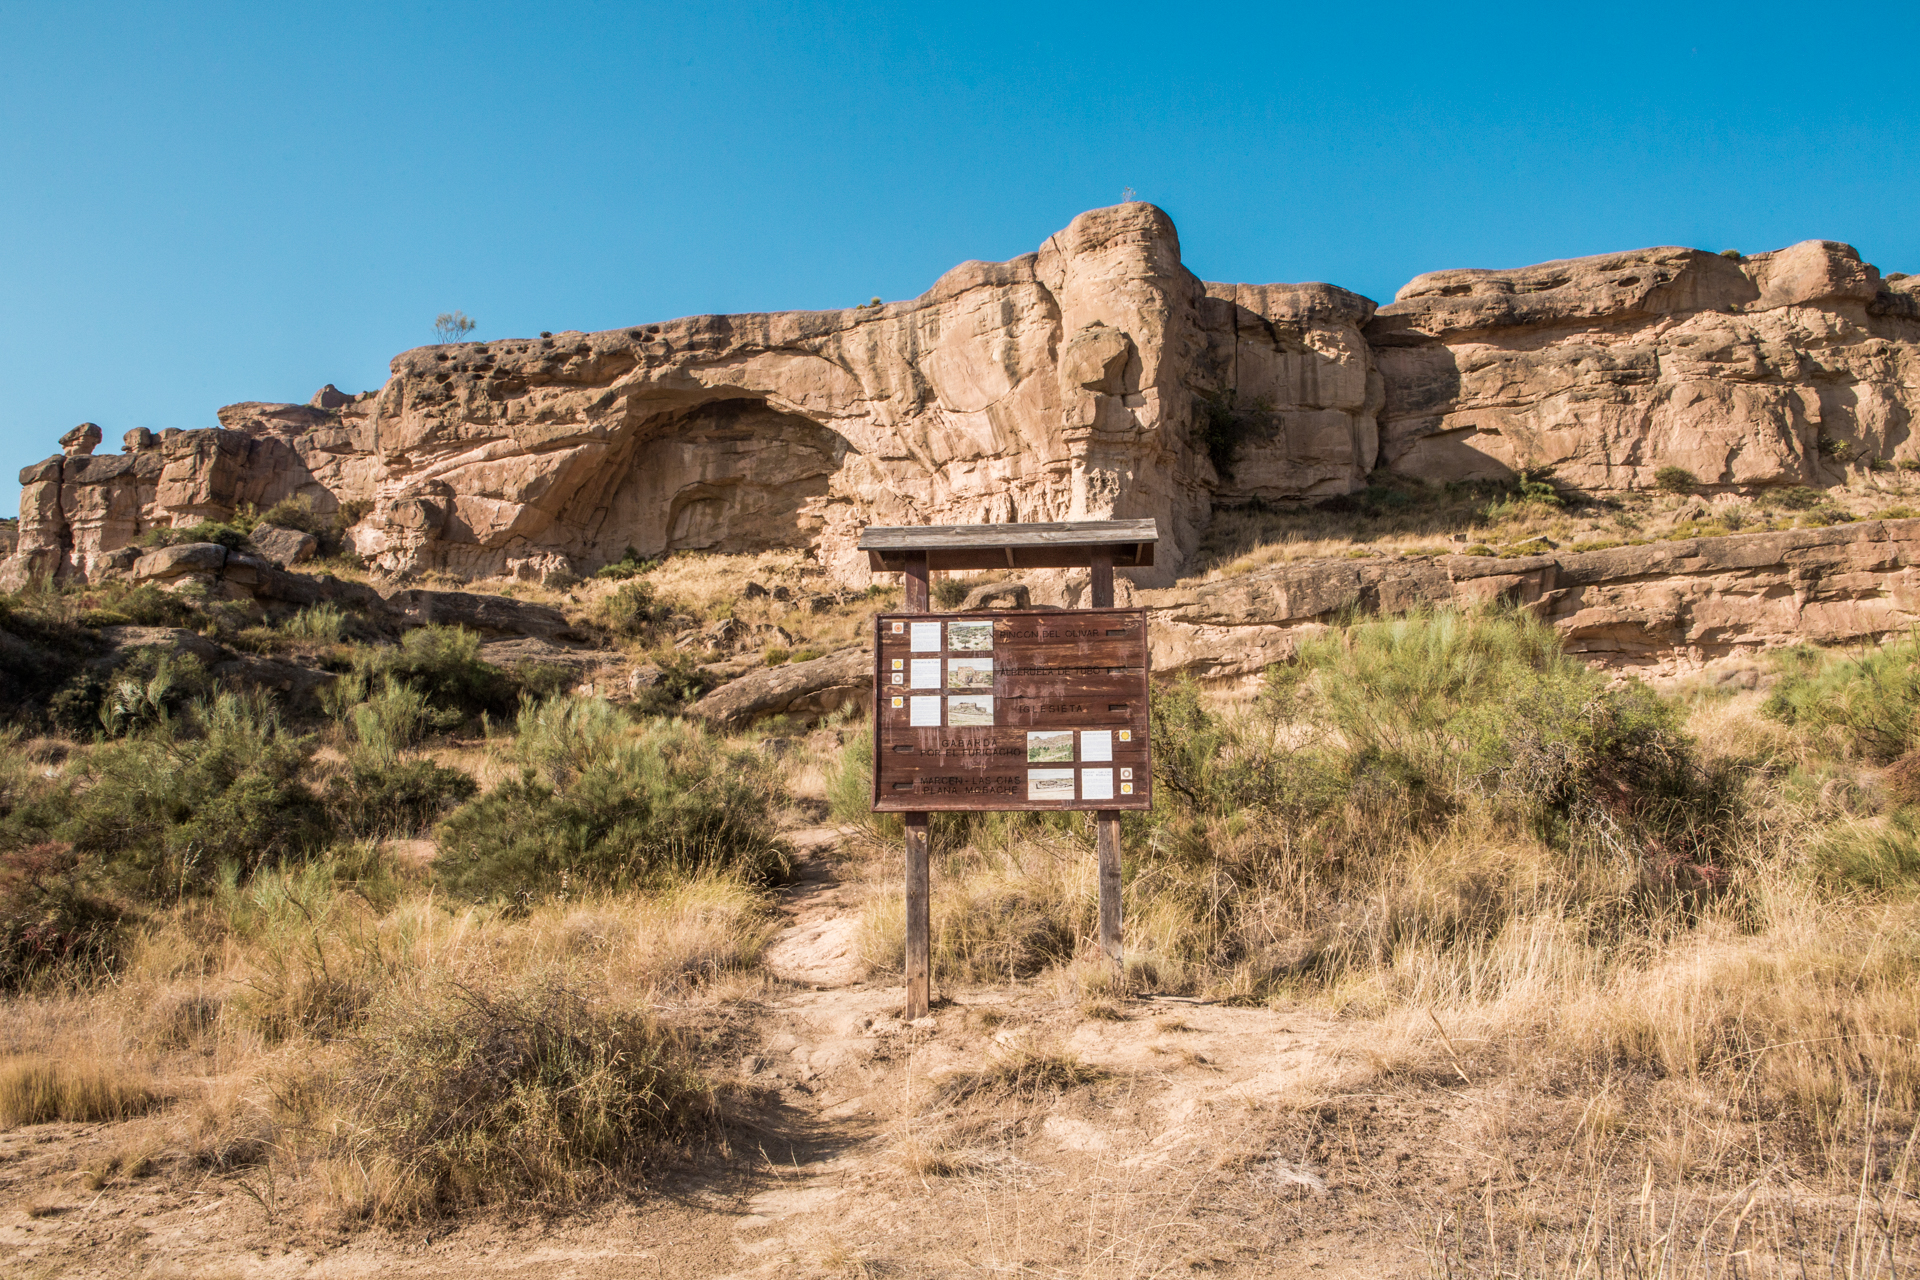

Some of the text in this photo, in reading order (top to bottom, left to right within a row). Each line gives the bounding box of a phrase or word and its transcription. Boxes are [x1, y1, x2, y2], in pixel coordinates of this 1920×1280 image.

[1042, 630, 1061, 638] DEL
[1065, 629, 1099, 638] OLIVAR
[1000, 666, 1101, 676] ALBERUELA DE TUBO
[1019, 704, 1083, 714] IGLESIETA
[941, 738, 998, 747] GABARDA
[920, 748, 1021, 757] POR EL FURICACHO
[972, 776, 992, 785] LAS
[995, 776, 1021, 785] CIAS
[923, 786, 957, 795] PLANA
